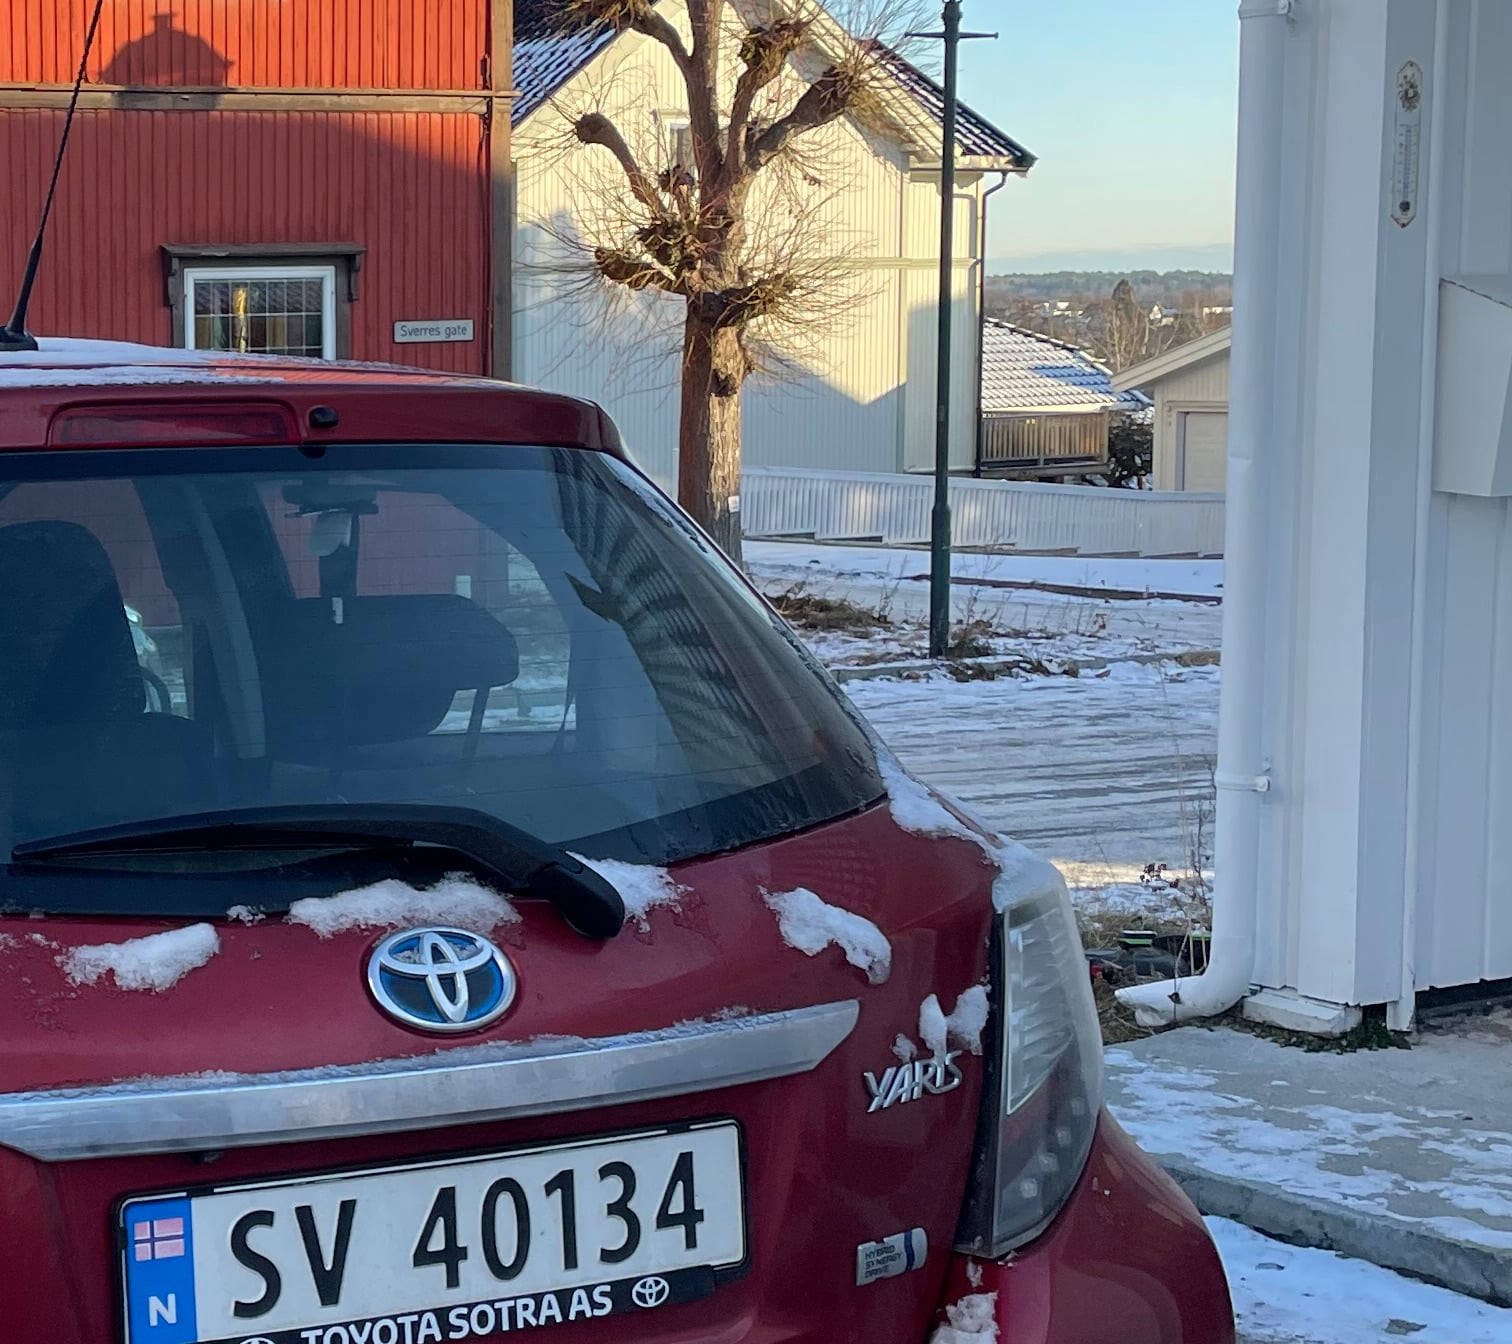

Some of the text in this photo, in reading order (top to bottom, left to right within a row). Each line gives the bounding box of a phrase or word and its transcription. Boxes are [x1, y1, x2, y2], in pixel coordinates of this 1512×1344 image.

[400, 324, 467, 339] Sverres gate
[863, 1051, 963, 1113] YARIS
[229, 1150, 705, 1318] SV 40134
[148, 1293, 177, 1326] N
[449, 1296, 563, 1337] SOTRA
[567, 1285, 613, 1319] AS
